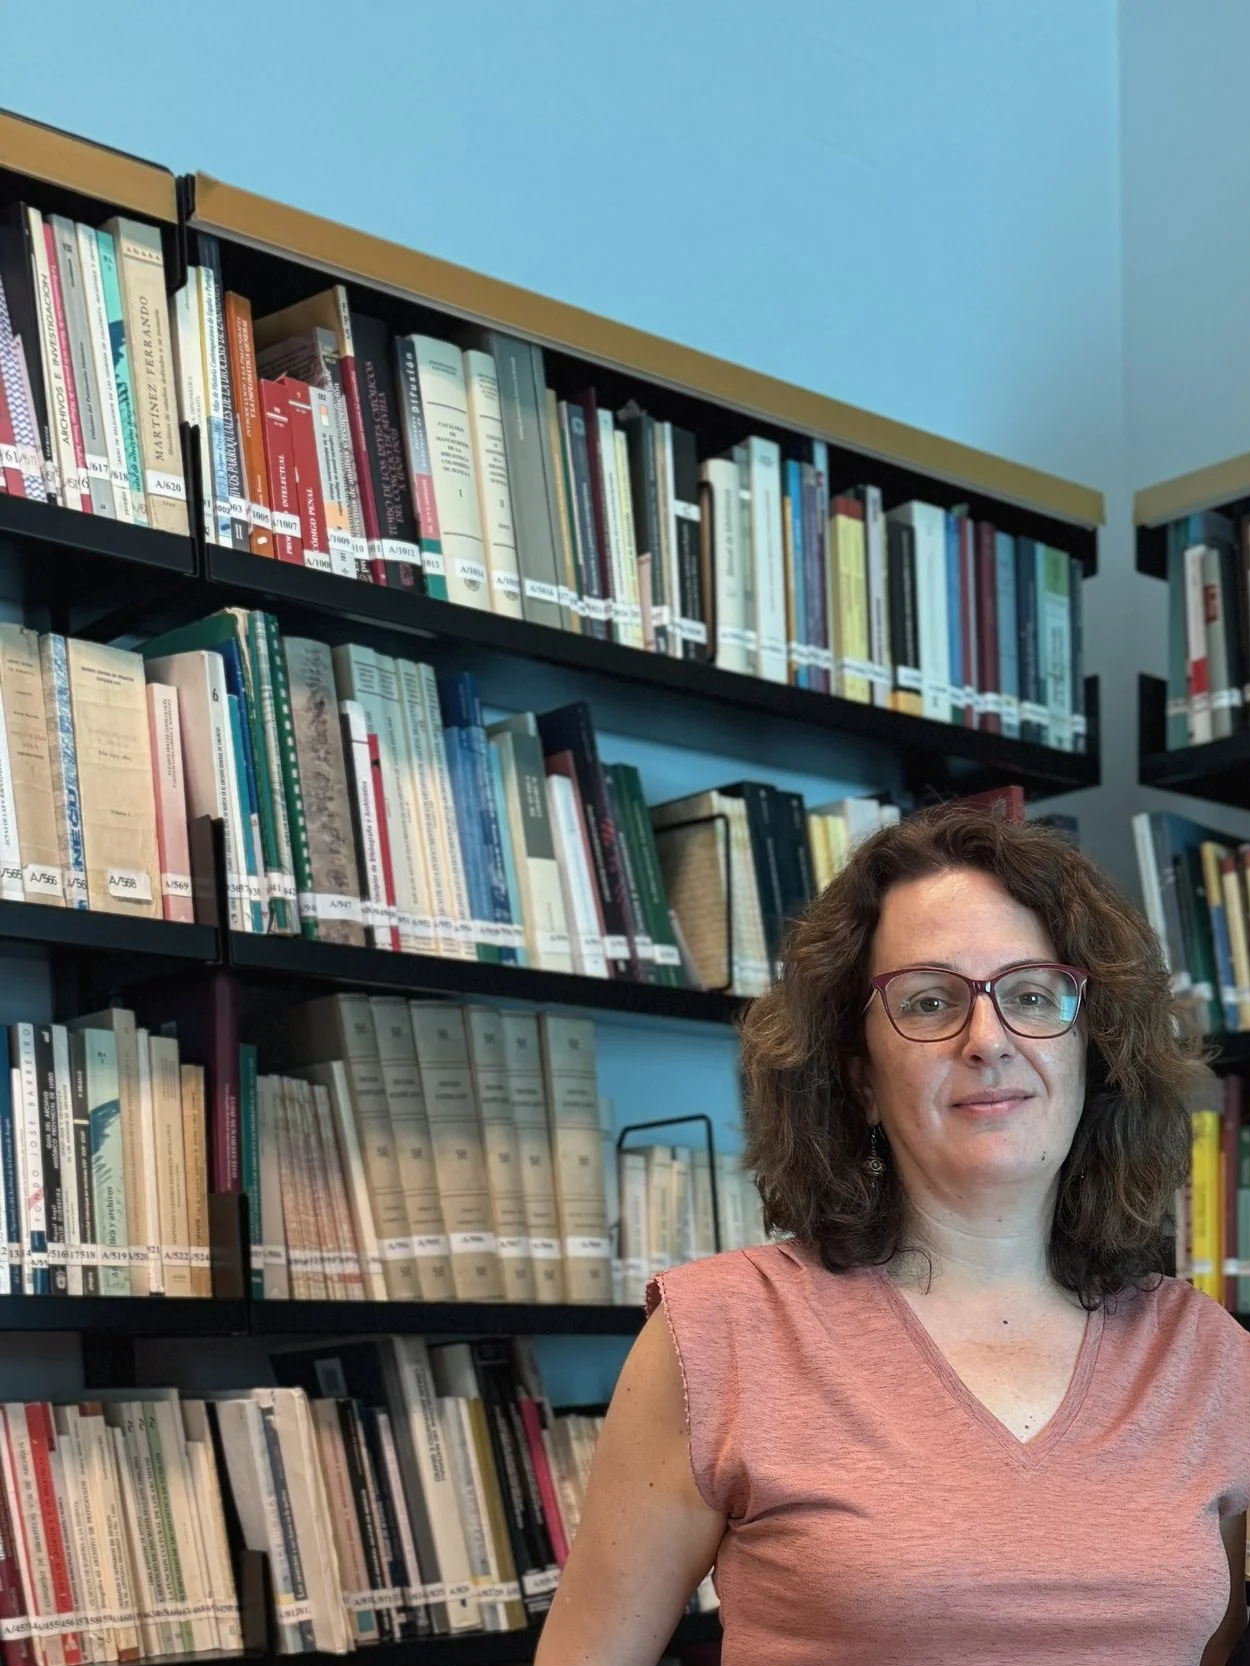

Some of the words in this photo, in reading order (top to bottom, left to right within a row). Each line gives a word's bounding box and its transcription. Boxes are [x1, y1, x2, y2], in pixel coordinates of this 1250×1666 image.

[139, 295, 157, 377] FERRANDO
[56, 387, 71, 445] ARCHIVOS
[155, 480, 181, 492] A/620
[31, 1170, 42, 1222] FONDO
[102, 1251, 127, 1261] A/519
[165, 1251, 188, 1260] A/522
